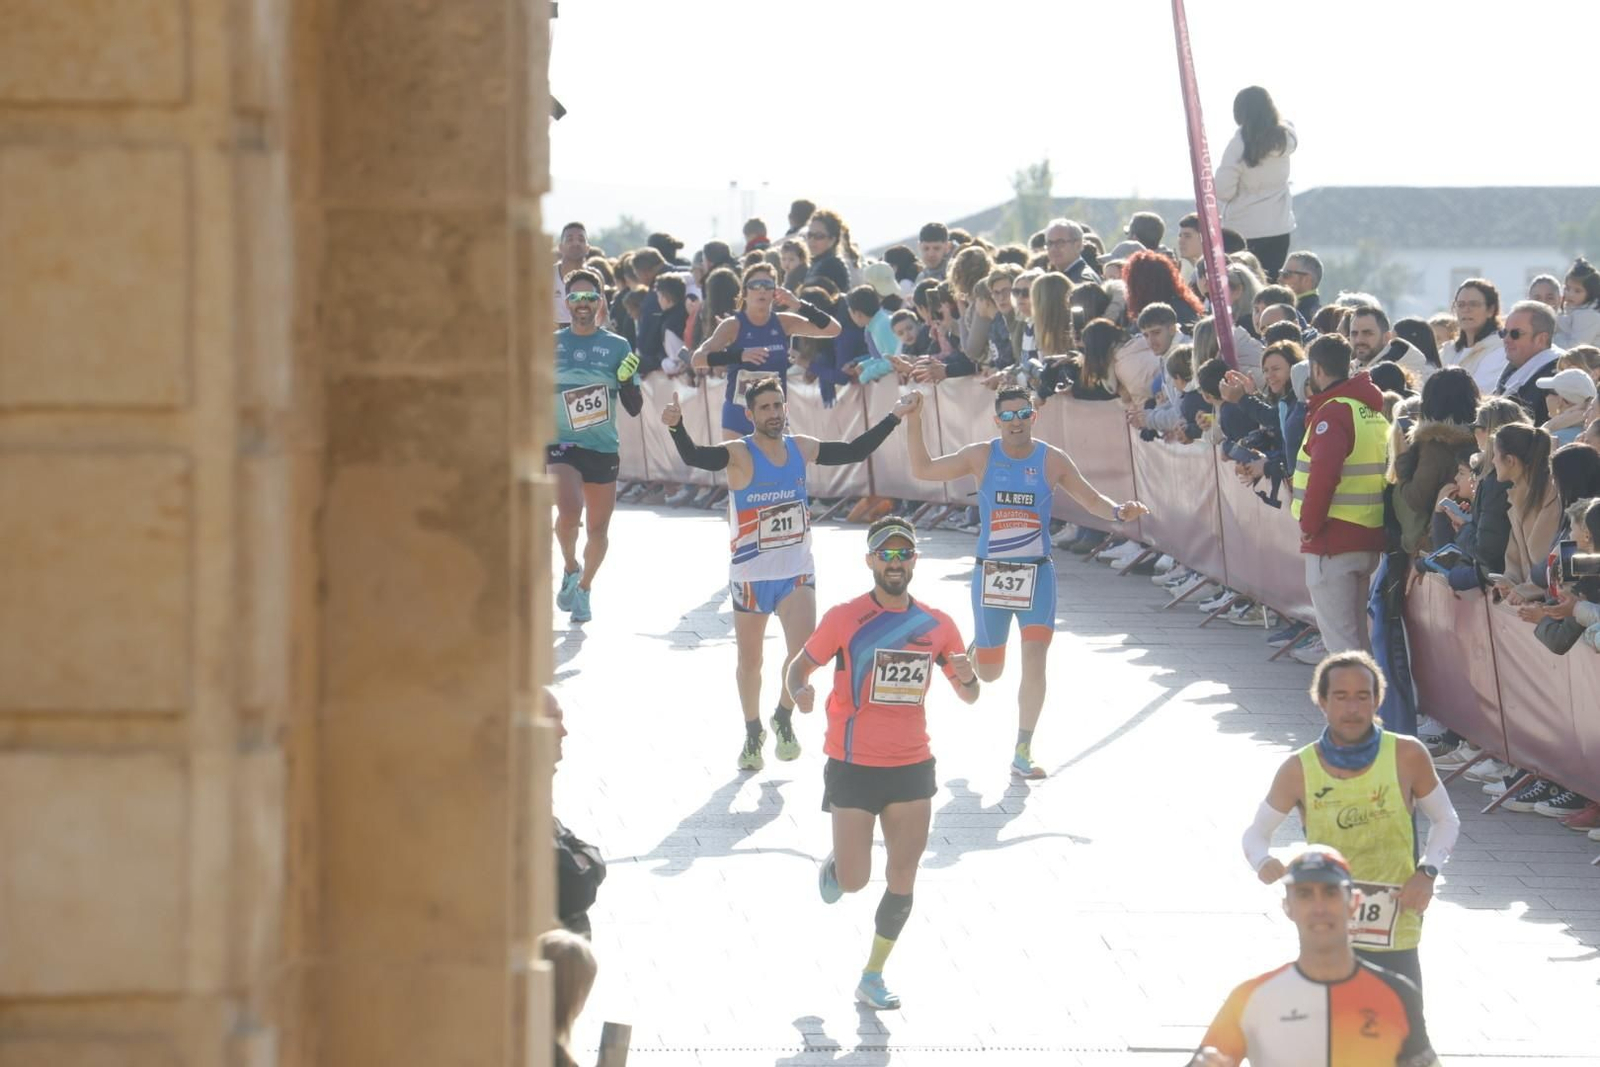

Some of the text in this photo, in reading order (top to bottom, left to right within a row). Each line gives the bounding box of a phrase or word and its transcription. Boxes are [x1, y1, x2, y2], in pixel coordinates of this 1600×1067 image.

[576, 396, 602, 412] 656
[746, 490, 797, 502] enerplus
[1013, 494, 1033, 504] REYES
[771, 516, 792, 532] 211
[992, 576, 1025, 591] 437
[880, 666, 924, 683] 1224
[1352, 903, 1381, 921] 18
